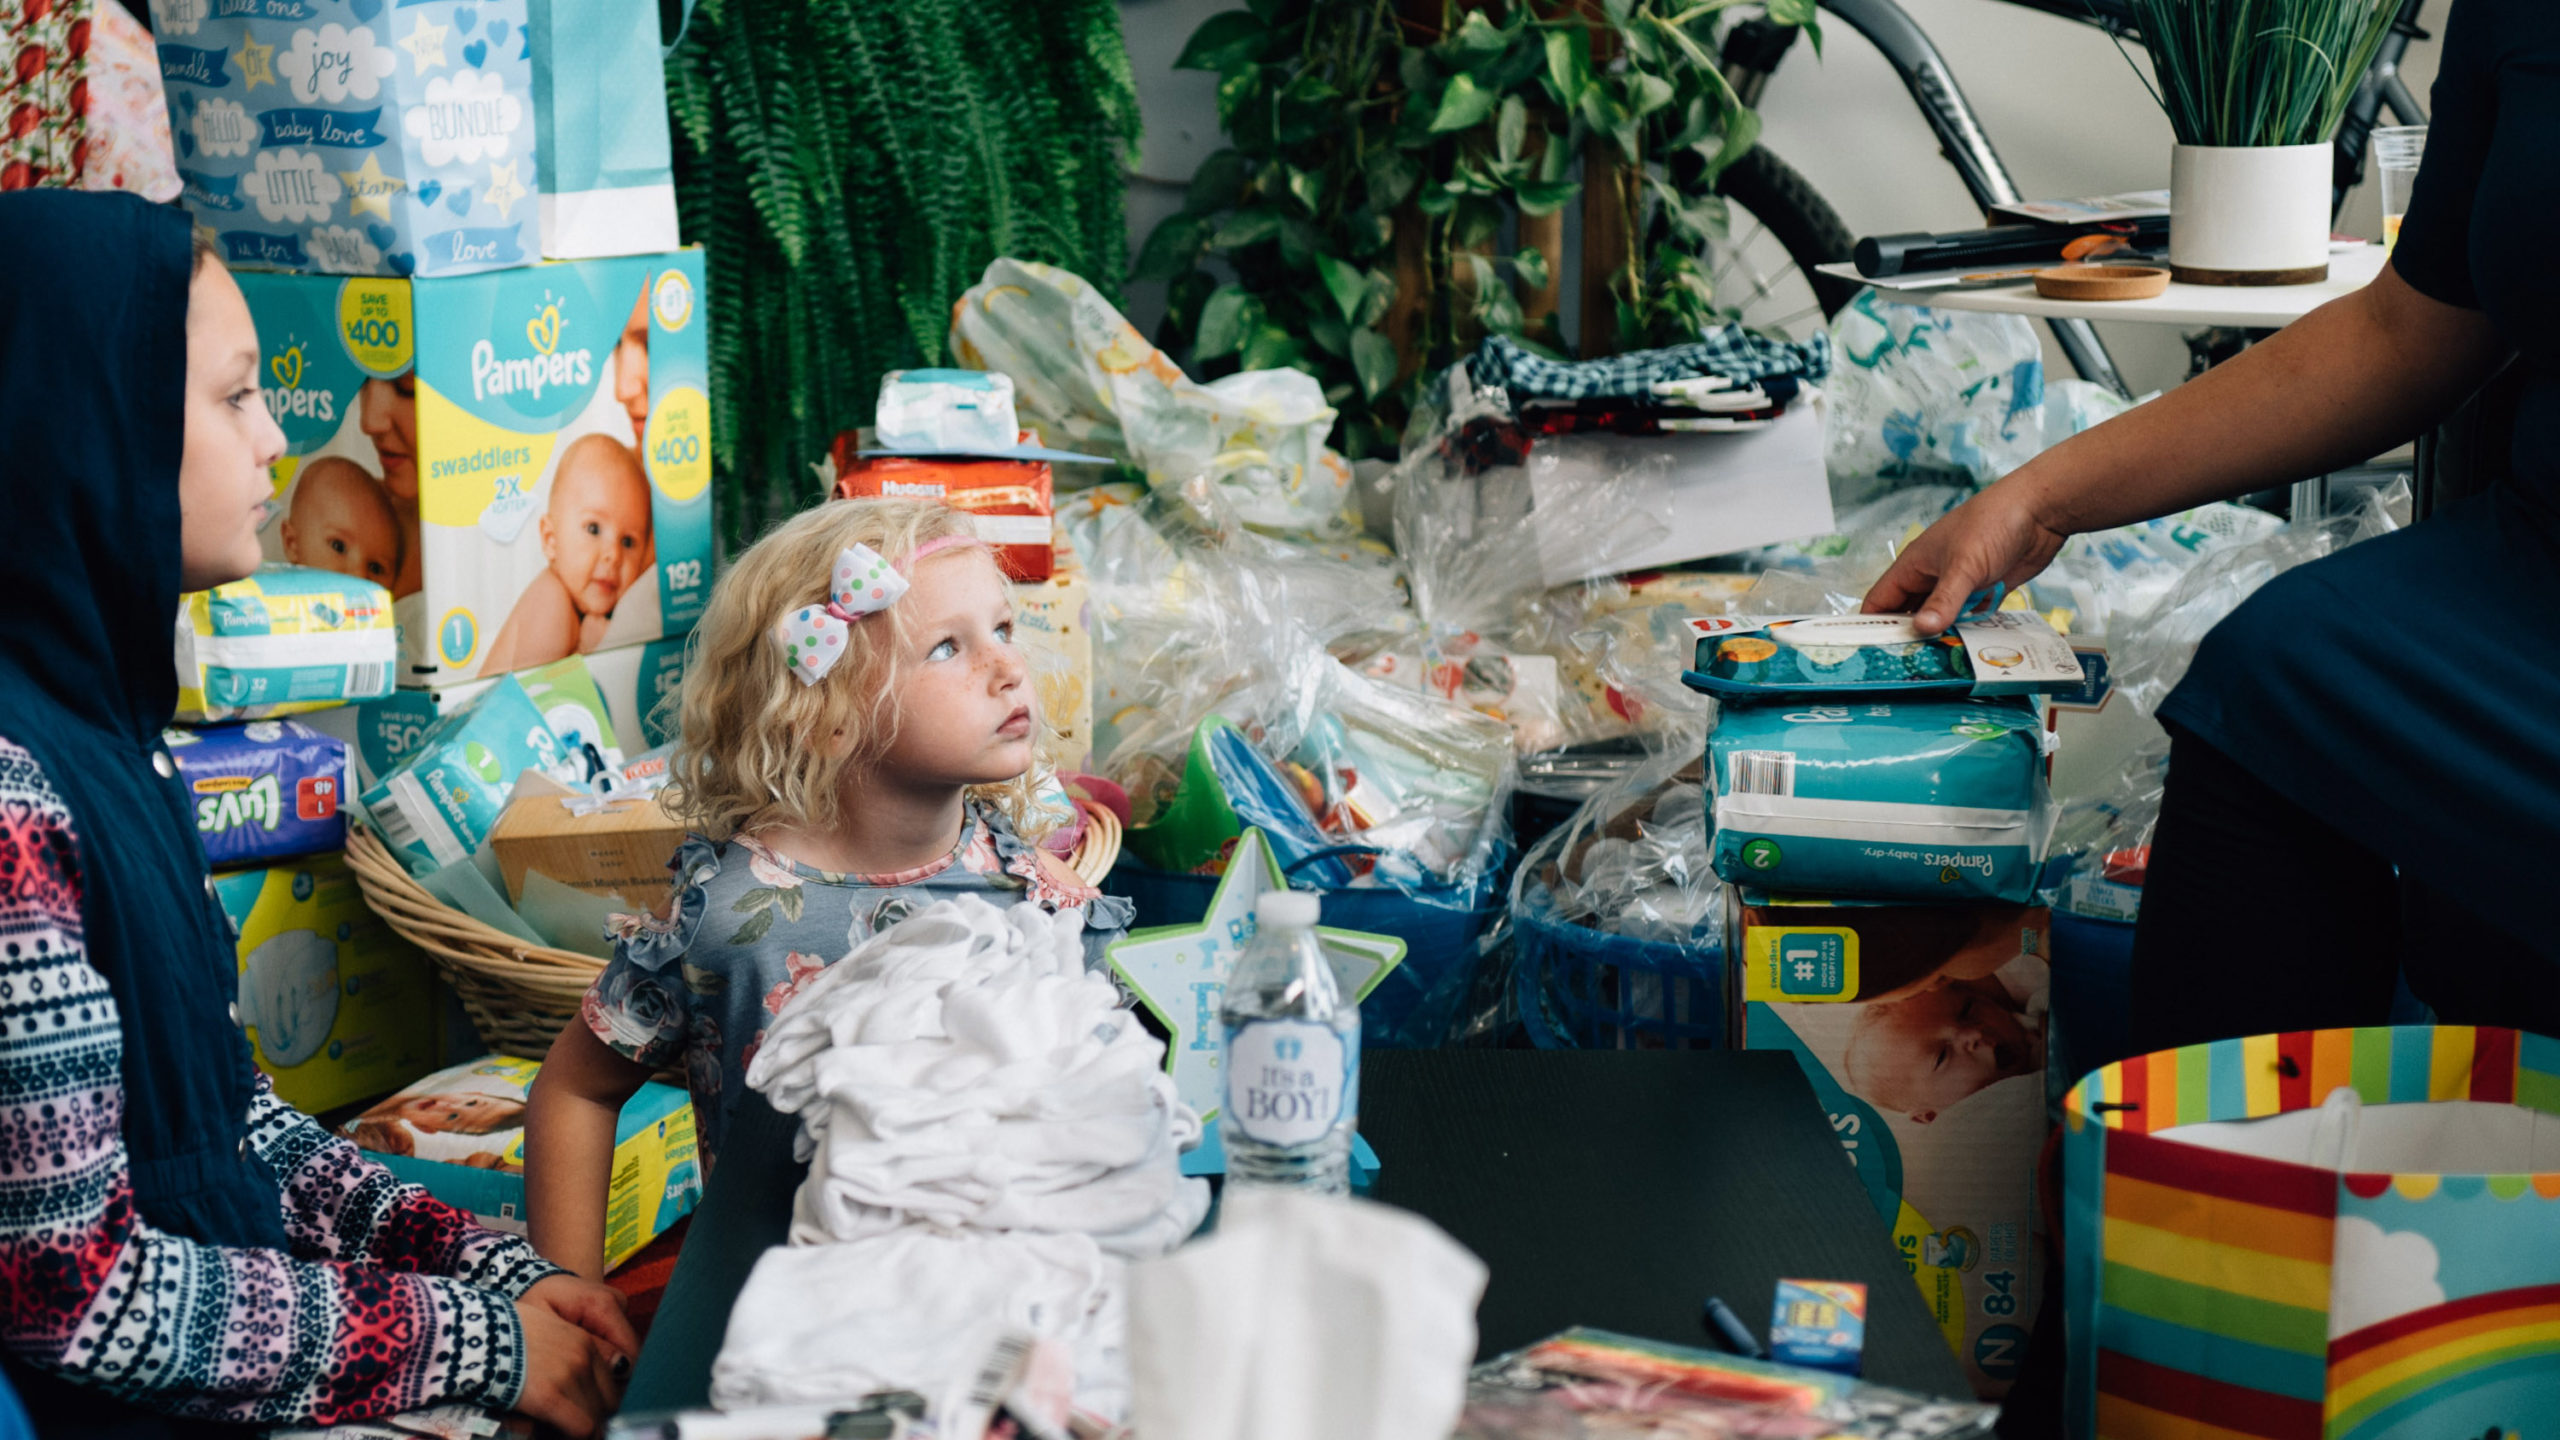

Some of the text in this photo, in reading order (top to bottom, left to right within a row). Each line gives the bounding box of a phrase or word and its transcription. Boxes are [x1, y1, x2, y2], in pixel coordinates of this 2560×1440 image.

[267, 1, 304, 18] one
[307, 42, 353, 94] joy
[272, 113, 367, 146] baby love
[428, 98, 504, 141] BUNDLE
[266, 169, 320, 205] LITTLE
[452, 230, 498, 262] love
[360, 293, 388, 306] SAVE
[471, 339, 591, 402] Pampers
[262, 387, 334, 424] pers
[431, 446, 531, 479] swaddlers
[494, 474, 521, 500] 2X
[665, 559, 701, 591] 192
[223, 610, 266, 627] Pampers
[452, 618, 461, 648] 1
[251, 677, 268, 691] 32
[314, 780, 333, 796] 48
[426, 768, 467, 824] Pampers
[317, 800, 324, 815] 1
[1753, 848, 1771, 868] 2
[1864, 846, 1994, 877] Pampers baby-dry
[1769, 939, 1778, 989] swaddlers
[1786, 950, 1819, 981] #1
[1262, 1065, 1315, 1087] It's a
[1247, 1088, 1331, 1123] BOY!
[1989, 1223, 2002, 1263] DIAPERS
[1983, 1270, 2016, 1316] 84
[1980, 1338, 2017, 1367] N
